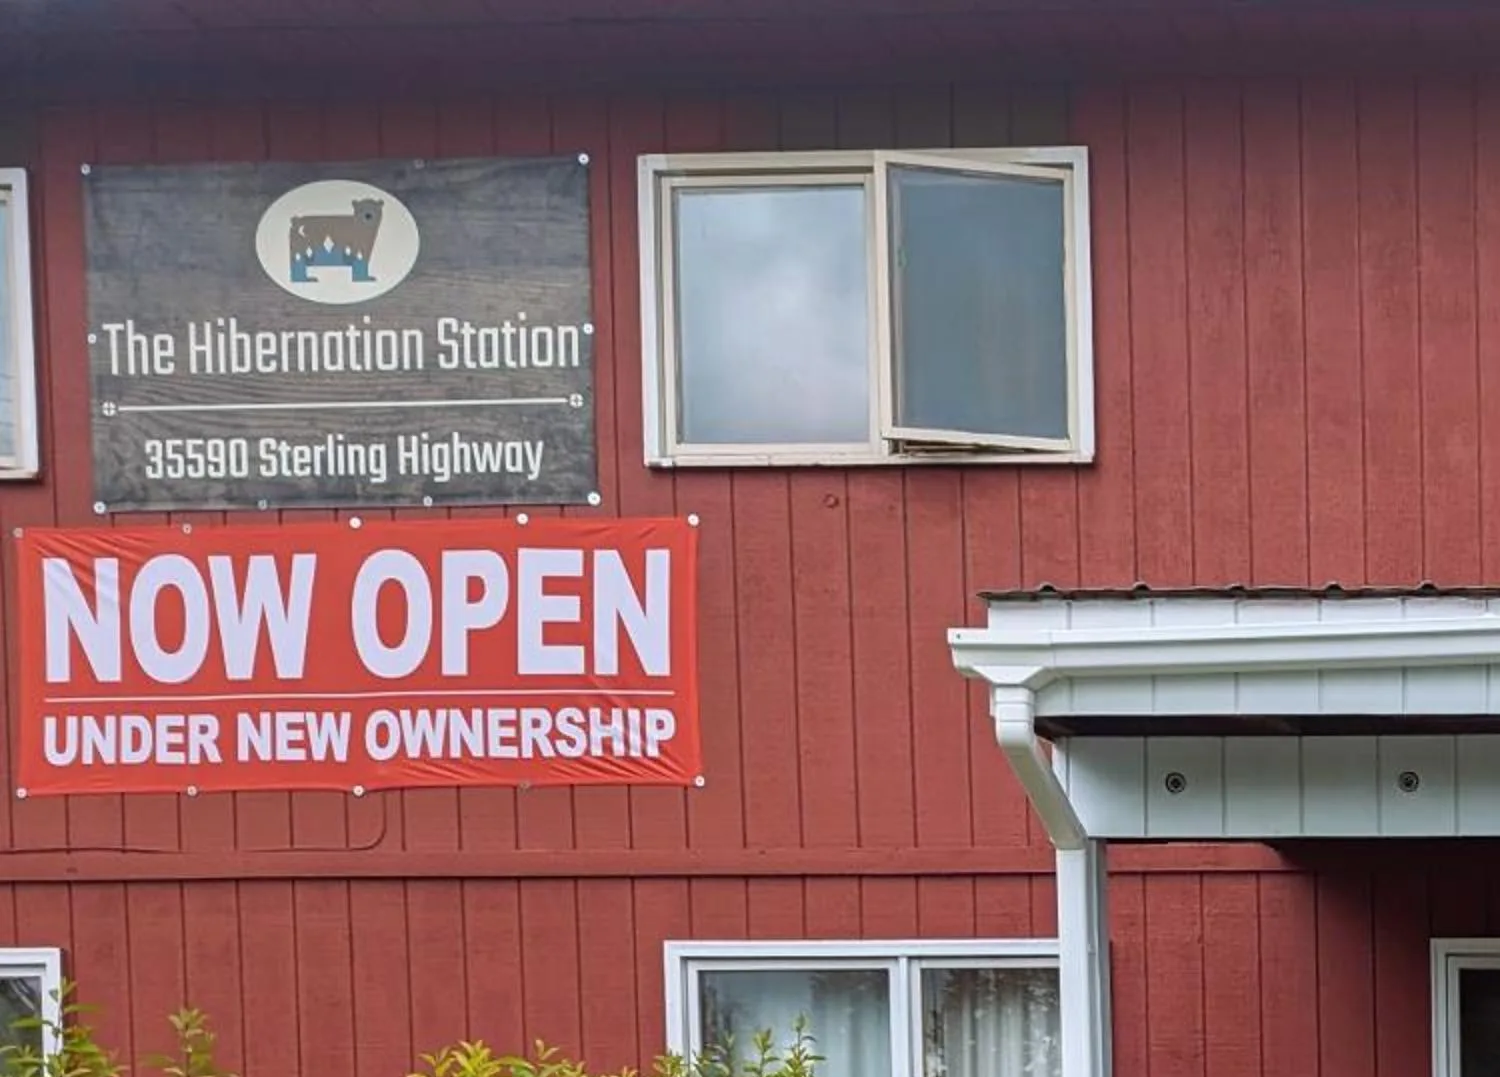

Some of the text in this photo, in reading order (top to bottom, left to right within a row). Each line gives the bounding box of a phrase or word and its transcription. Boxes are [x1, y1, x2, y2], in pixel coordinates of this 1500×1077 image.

[102, 311, 580, 376] The Hibernation Station
[145, 432, 544, 483] 35590 Sterling Highway
[42, 548, 670, 683] NOW OPEN
[44, 707, 676, 766] UNDER NEW OWNERSHIP
